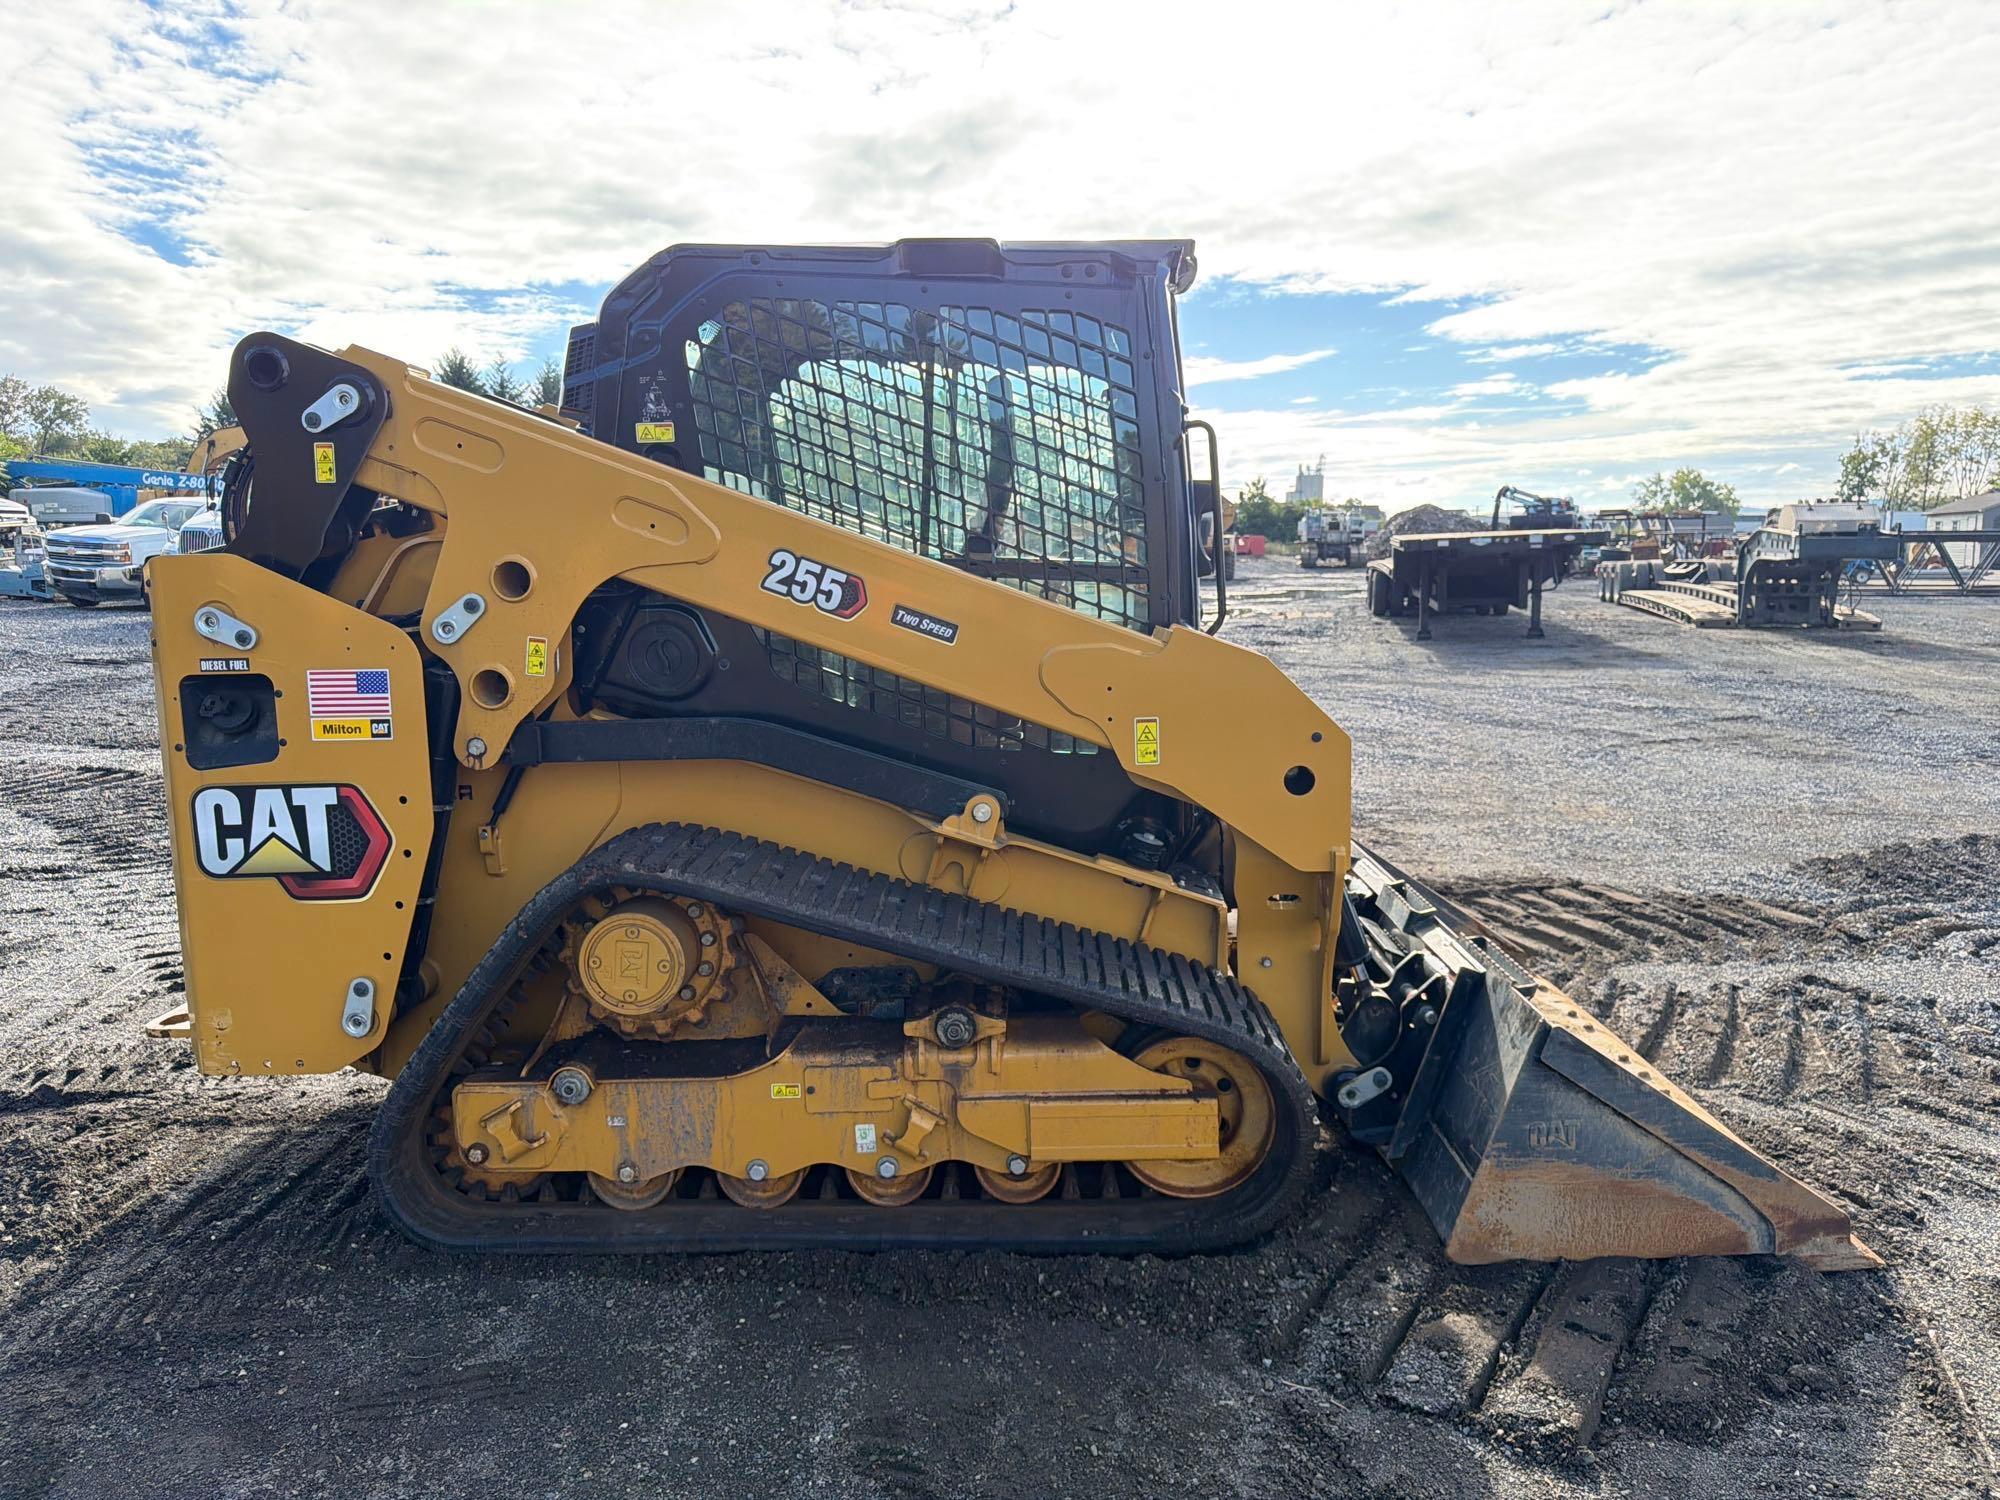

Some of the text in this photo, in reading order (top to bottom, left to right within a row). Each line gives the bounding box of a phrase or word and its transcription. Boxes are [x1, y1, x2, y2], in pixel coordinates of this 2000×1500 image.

[142, 472, 174, 487] Genie
[763, 551, 849, 611] 255
[201, 660, 249, 671] DIESEL FUEL
[322, 723, 389, 735] Milton CAT
[194, 787, 338, 875] CAT
[1529, 1119, 1581, 1152] CAT
